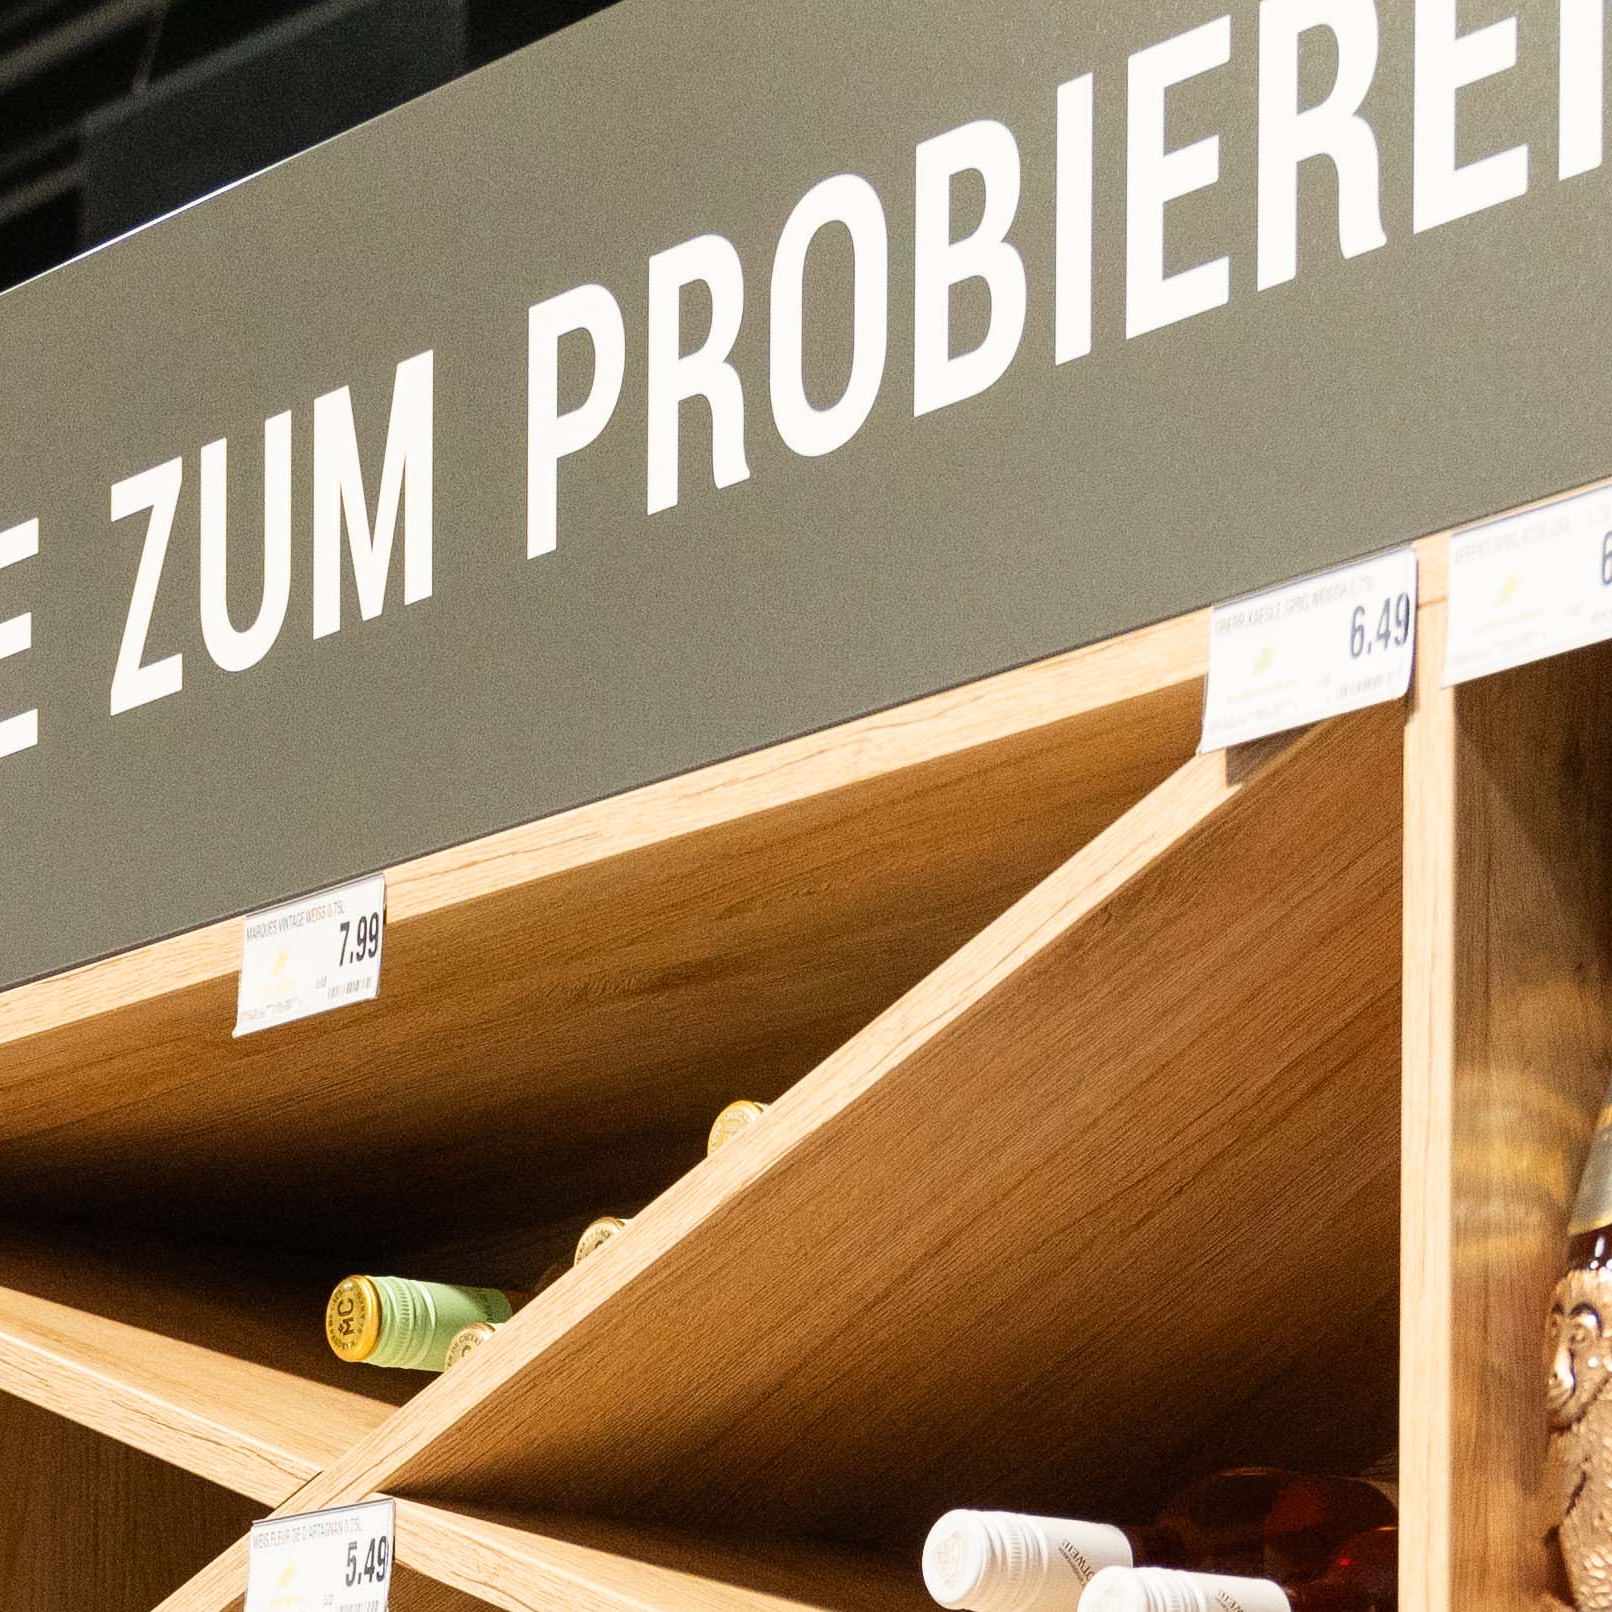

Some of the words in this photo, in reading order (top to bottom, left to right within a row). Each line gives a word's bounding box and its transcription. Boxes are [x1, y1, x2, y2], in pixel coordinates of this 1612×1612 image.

[109, 350, 434, 716] ZUM
[1349, 591, 1410, 659] 6.49
[339, 912, 379, 967] 7.99
[346, 1536, 389, 1587] 5.49
